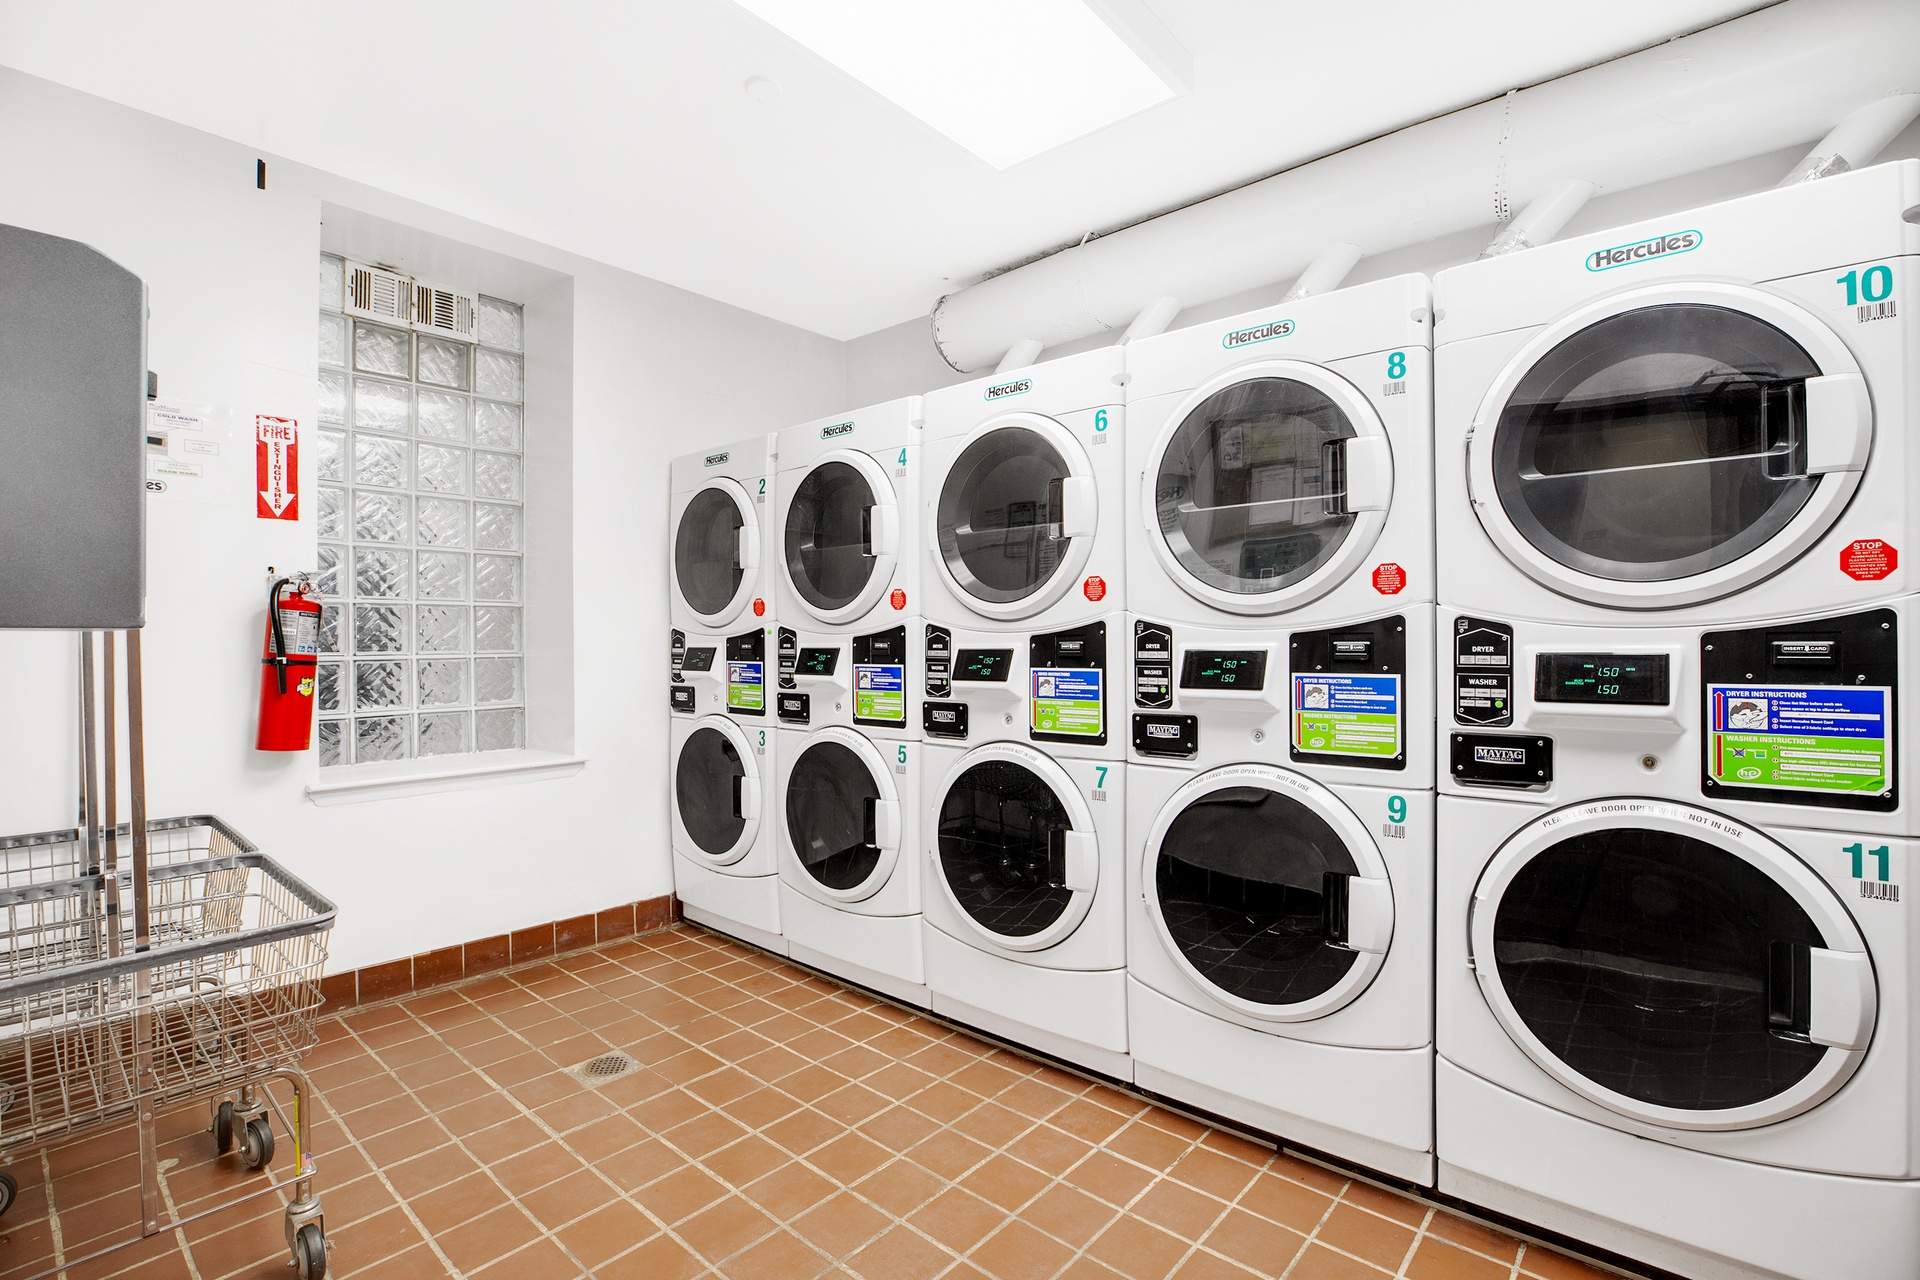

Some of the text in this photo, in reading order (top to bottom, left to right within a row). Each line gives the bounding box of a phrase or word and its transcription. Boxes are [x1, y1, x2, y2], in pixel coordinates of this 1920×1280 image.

[1595, 234, 1694, 268] Hercules
[1837, 265, 1893, 306] 10
[1228, 322, 1290, 346] Hercules
[1387, 351, 1407, 380] 8
[988, 381, 1029, 398] Hercules
[822, 423, 853, 437] Hercules
[1095, 409, 1108, 432] 6
[263, 424, 291, 441] FIRE
[706, 454, 728, 465] Hercules
[898, 447, 907, 466] 4
[273, 441, 282, 510] EXTINGUISHER
[759, 478, 766, 494] 2
[1853, 542, 1882, 550] STOP
[759, 730, 766, 746] 3
[1149, 726, 1178, 734] MAYTAG
[1760, 736, 1816, 745] INSTRUCTIONS
[898, 744, 907, 764] 5
[1478, 748, 1522, 759] MAYTAG
[1096, 766, 1108, 788] 7
[1388, 795, 1407, 824] 9
[1542, 804, 1744, 839] PLEASE LEAVE DOOR OPEN WHEN NOT IN USE
[1842, 843, 1889, 882] 11
